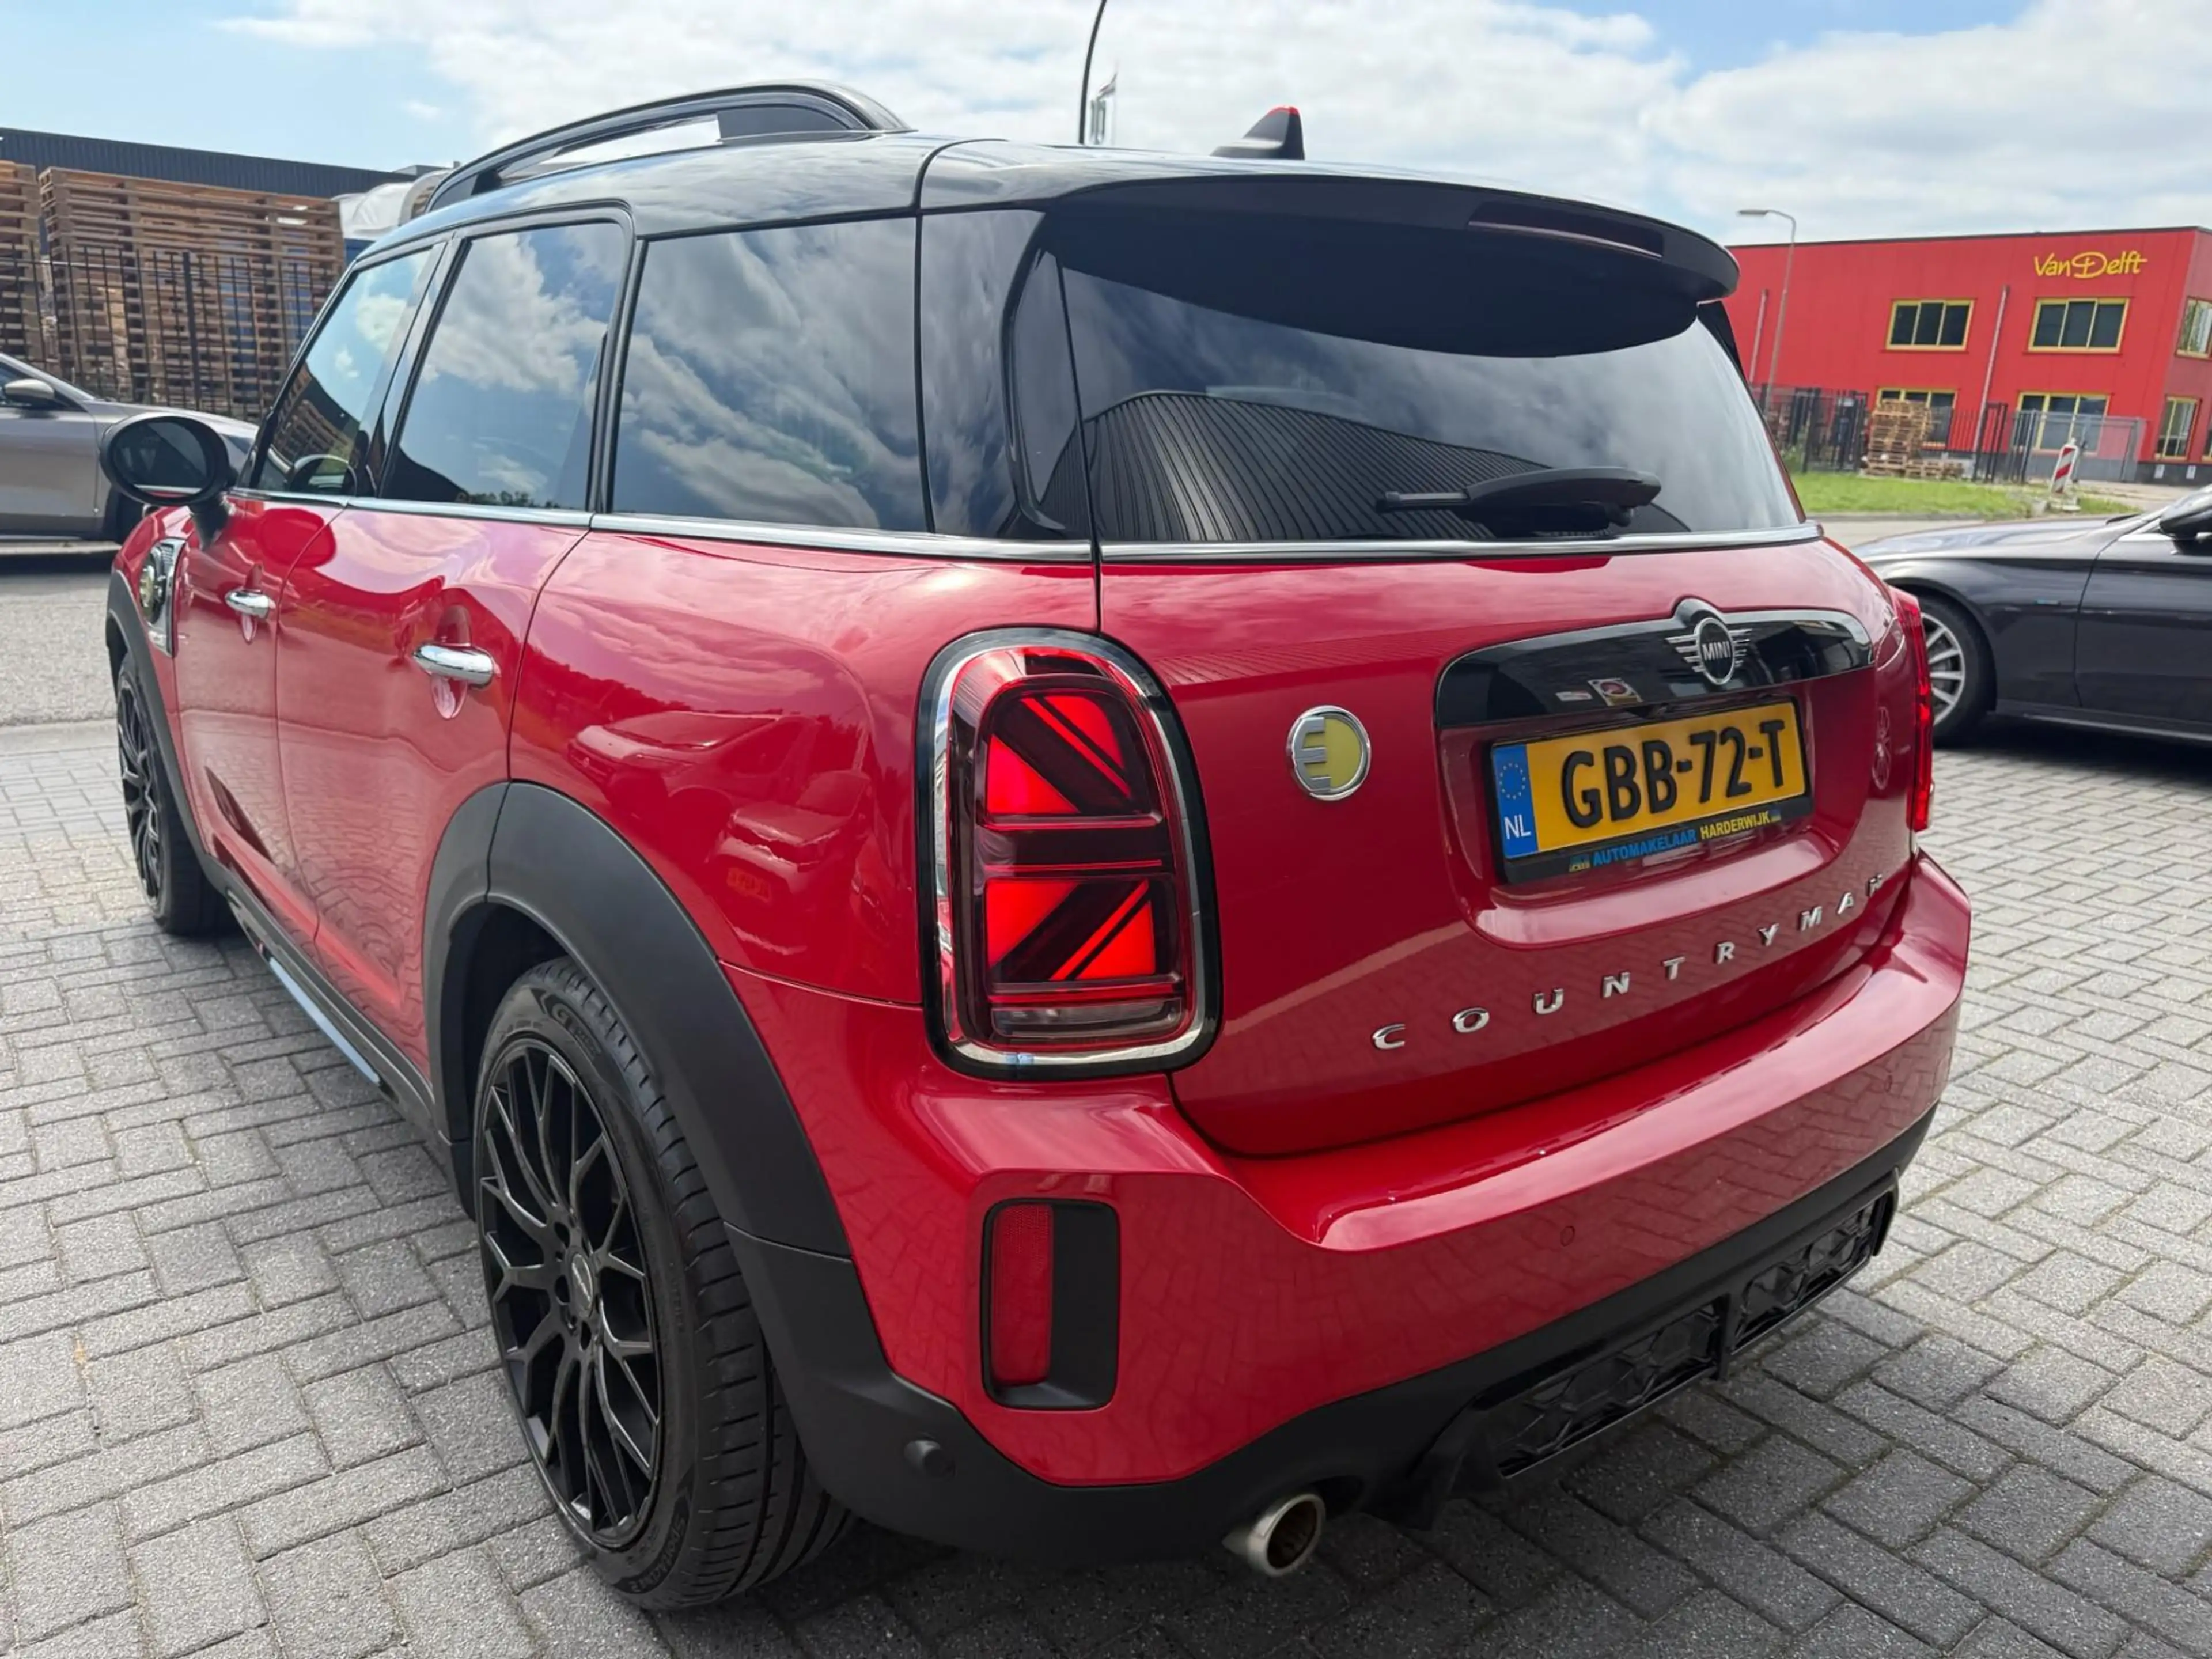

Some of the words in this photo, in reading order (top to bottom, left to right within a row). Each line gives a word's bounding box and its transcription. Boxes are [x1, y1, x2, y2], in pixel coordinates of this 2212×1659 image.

[2071, 249, 2149, 279] Delft
[1702, 640, 1731, 661] MINI
[1561, 719, 1786, 828] GBB-72-T
[1505, 813, 1531, 839] NL
[1592, 828, 1697, 867] AUTOMAKELAAR
[1700, 809, 1771, 840] HARDERWIJK
